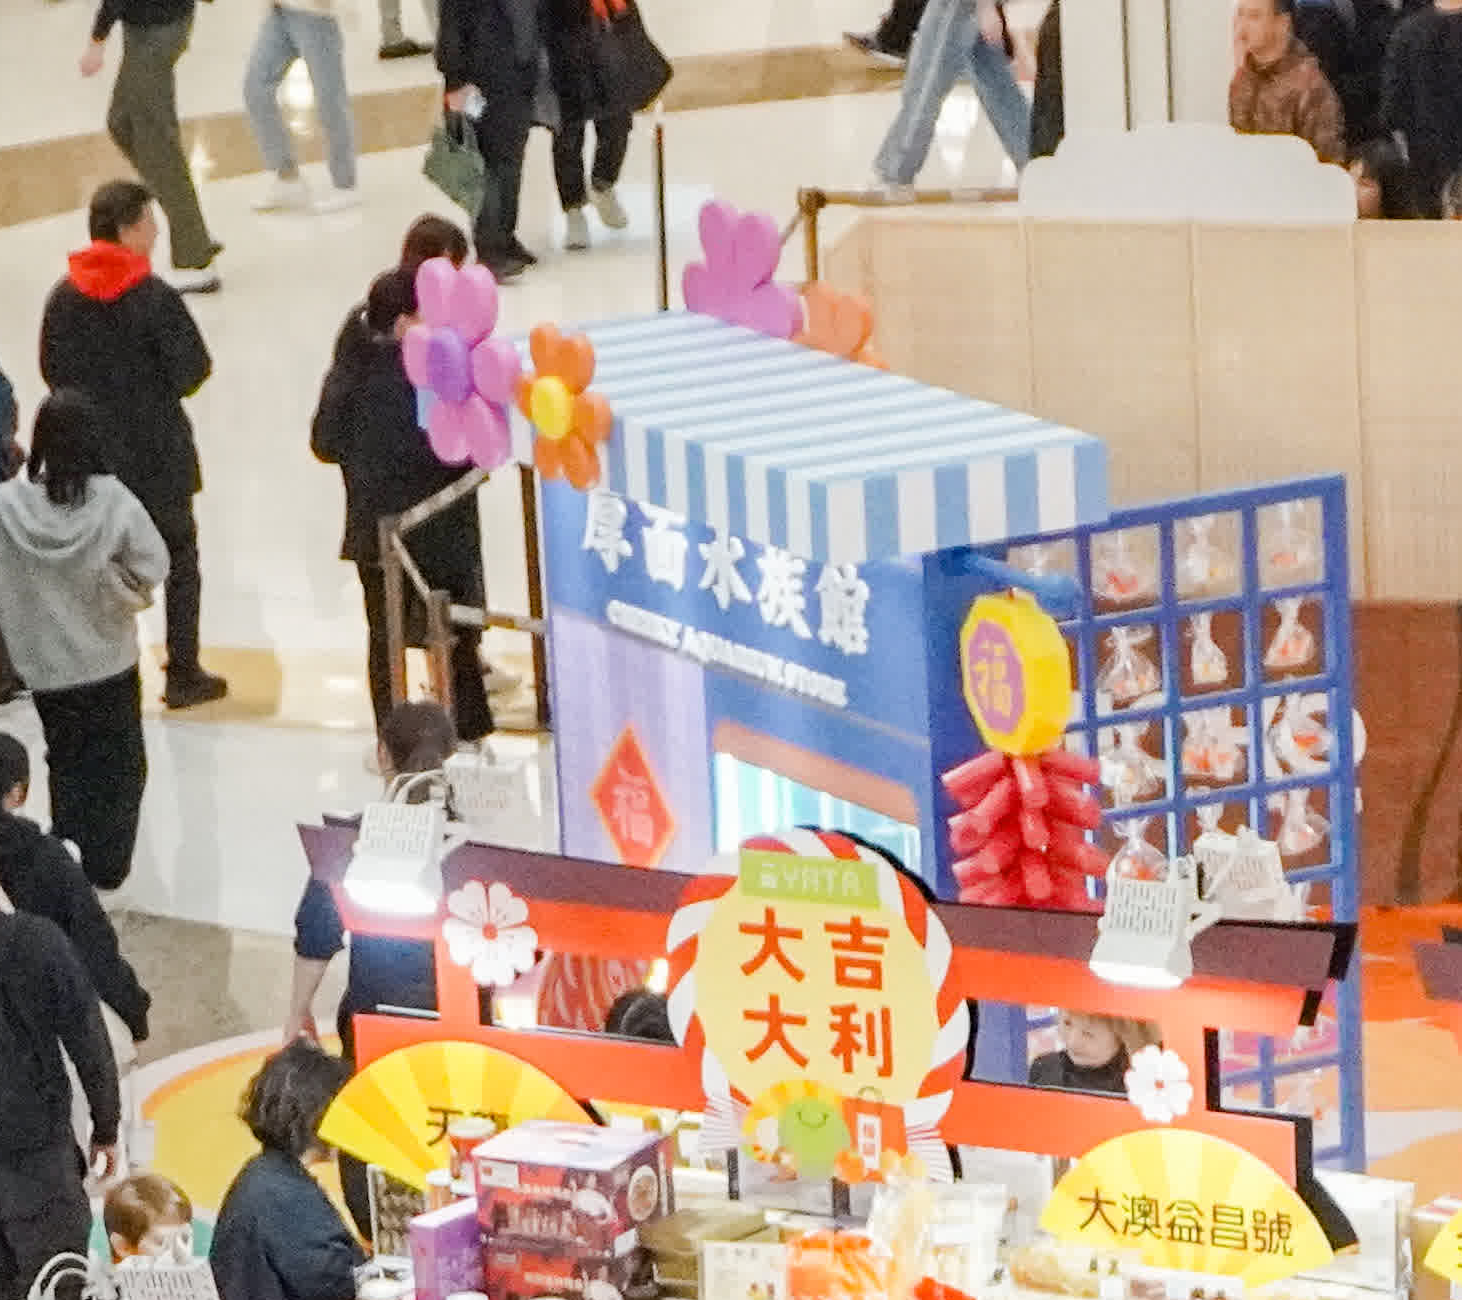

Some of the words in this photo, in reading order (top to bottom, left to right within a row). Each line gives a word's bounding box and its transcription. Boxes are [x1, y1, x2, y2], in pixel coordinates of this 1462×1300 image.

[739, 906, 890, 992] 大吉
[743, 994, 893, 1078] 大利
[1078, 1188, 1295, 1259] 大澳益昌號
